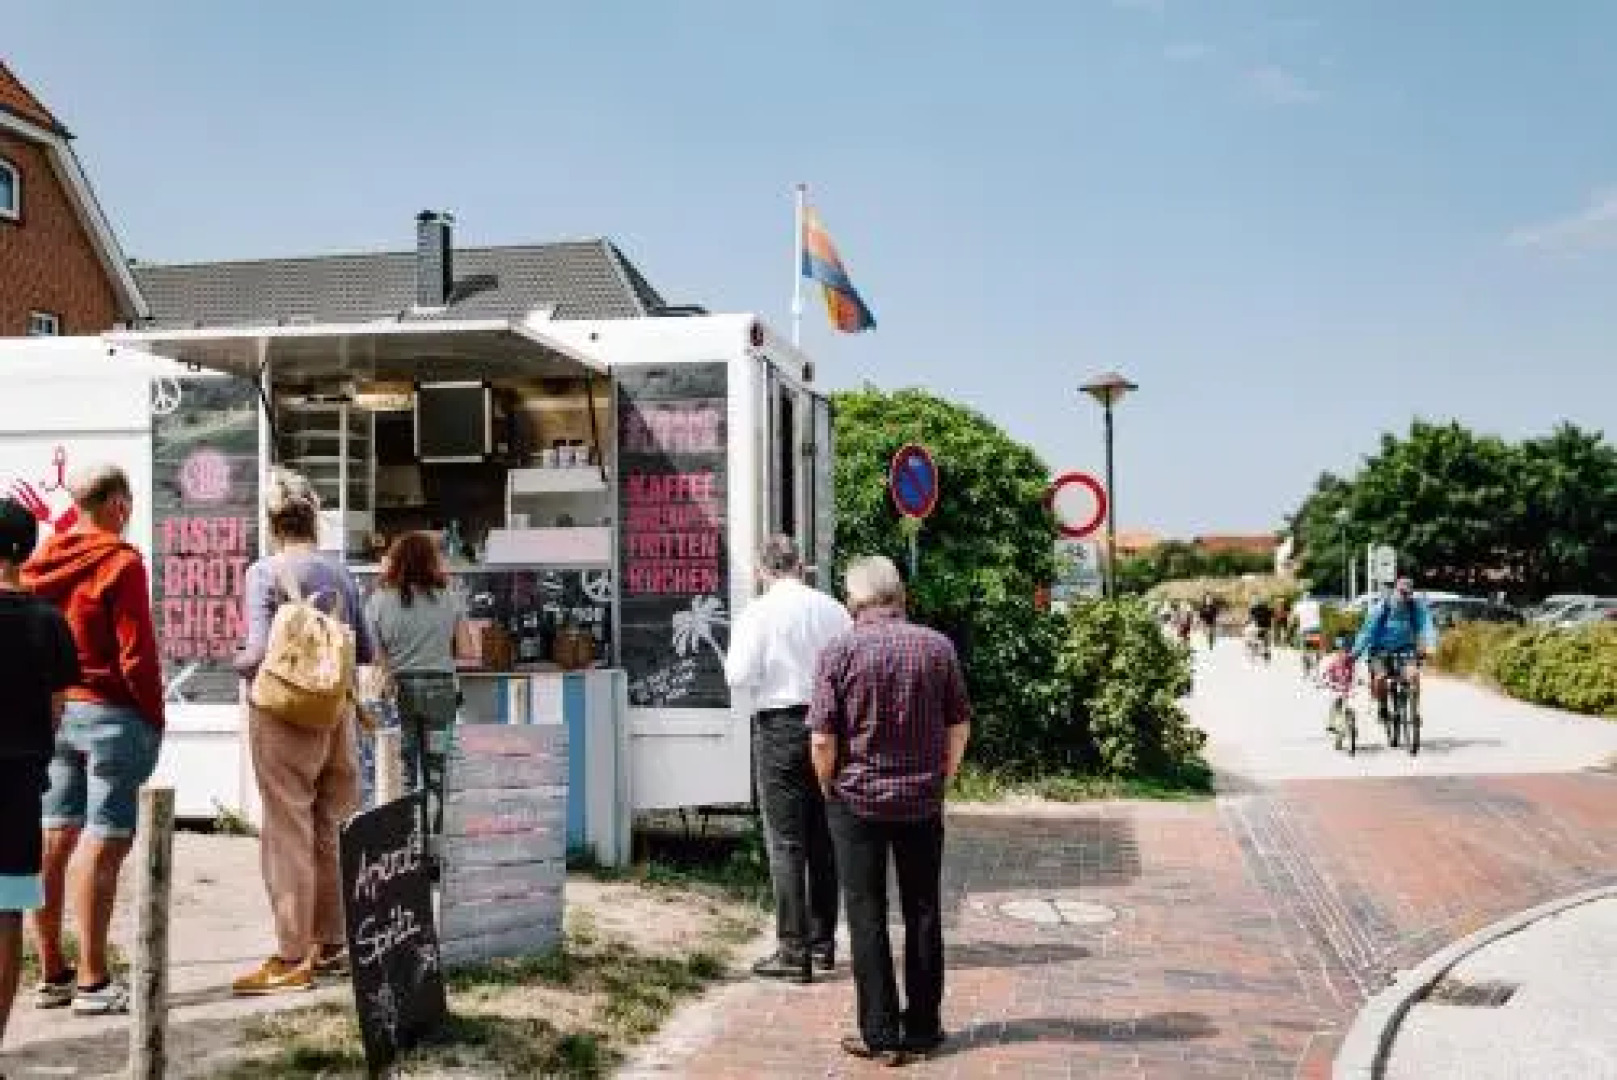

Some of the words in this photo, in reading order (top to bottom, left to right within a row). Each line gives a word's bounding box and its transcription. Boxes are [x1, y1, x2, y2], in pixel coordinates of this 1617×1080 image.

[627, 473, 715, 501] KAFFEE
[164, 517, 247, 553] FISCH
[627, 532, 716, 557] FRITTEN
[163, 599, 249, 637] CHEN
